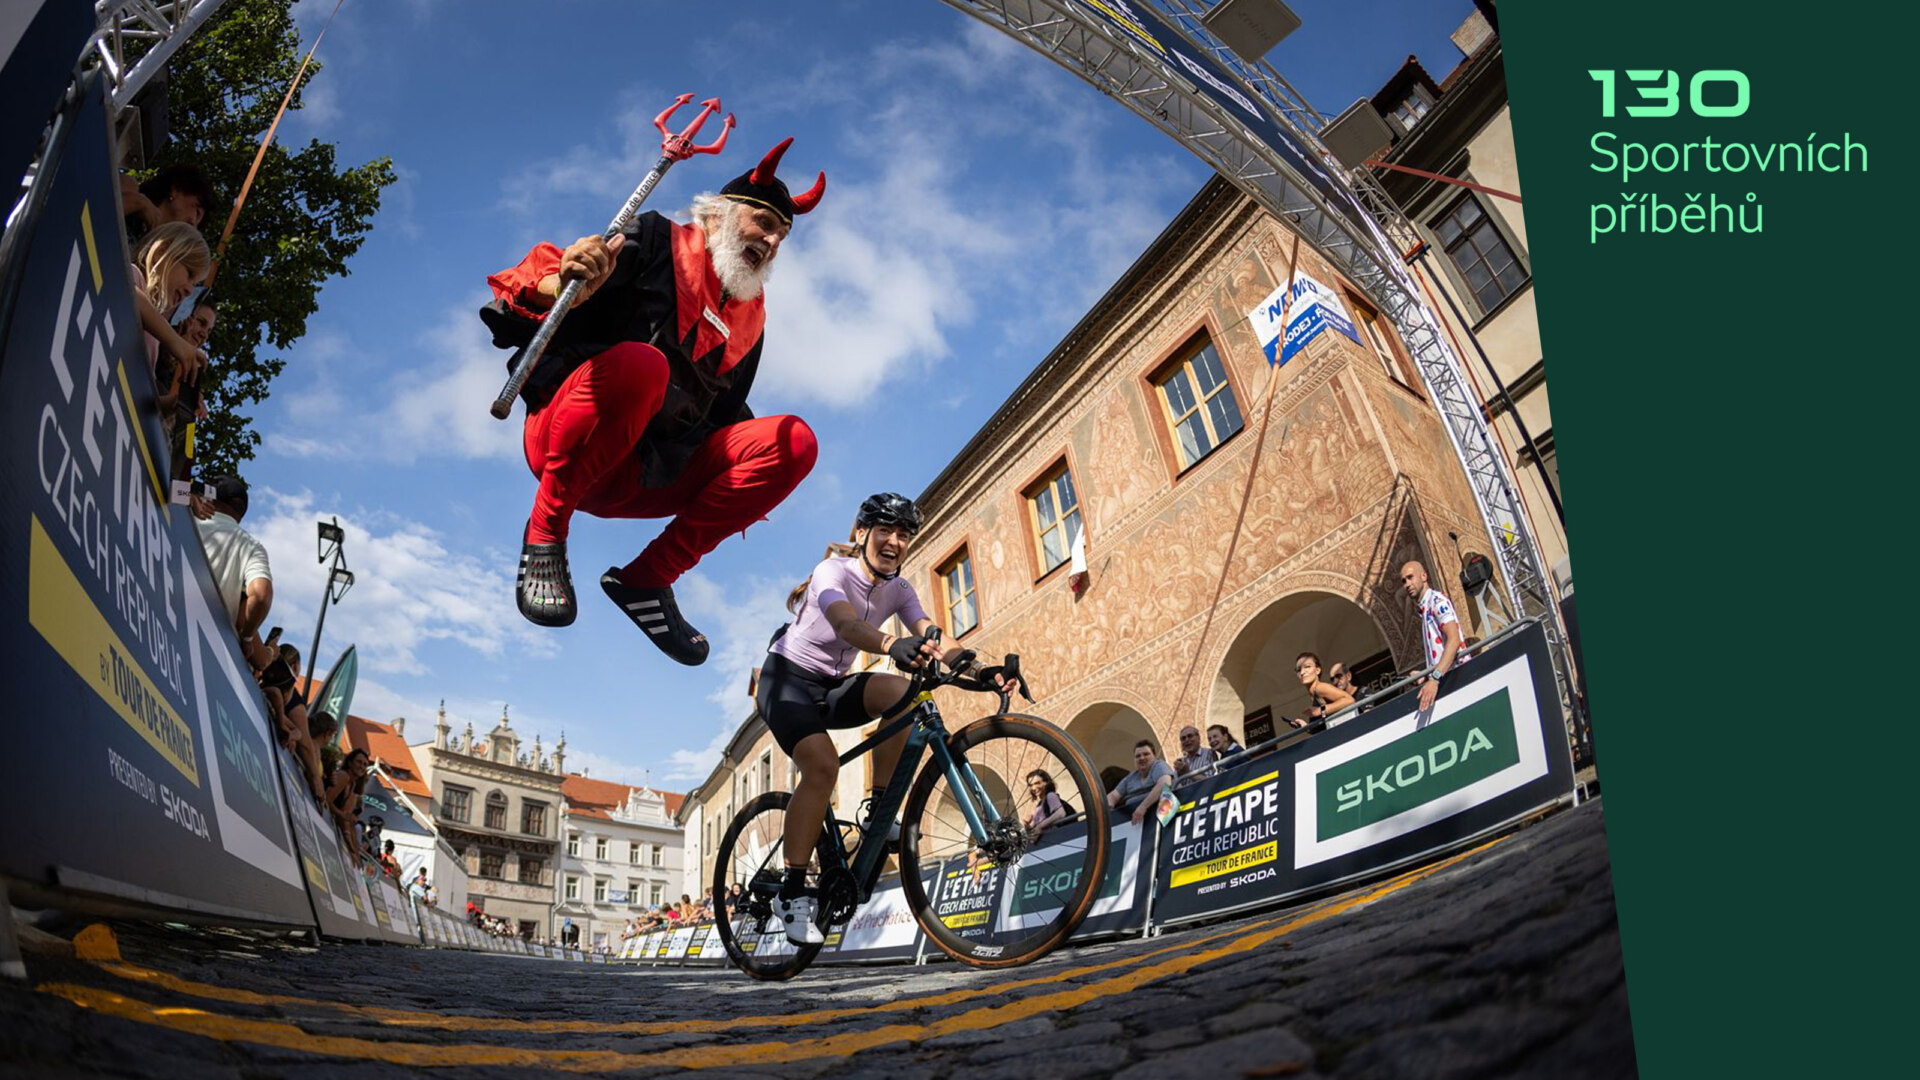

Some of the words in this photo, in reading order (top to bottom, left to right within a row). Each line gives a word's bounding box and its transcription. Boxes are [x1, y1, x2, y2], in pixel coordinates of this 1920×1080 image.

[614, 207, 632, 227] Tour
[629, 196, 640, 208] de
[636, 172, 658, 198] France
[38, 403, 109, 595] CZECH
[115, 544, 187, 705] REPUBLIC
[100, 652, 111, 688] BY
[109, 643, 145, 725] TOUR
[160, 705, 194, 773] FRANCE
[108, 748, 149, 799] PRESENTED
[1172, 839, 1210, 865] CZECH
[1213, 817, 1278, 853] REPUBLIC
[1207, 861, 1227, 875] TOUR
[1229, 857, 1239, 868] DE
[1240, 846, 1274, 865] FRANCE
[938, 900, 960, 915] CZECH
[958, 894, 994, 912] REPUBLIC
